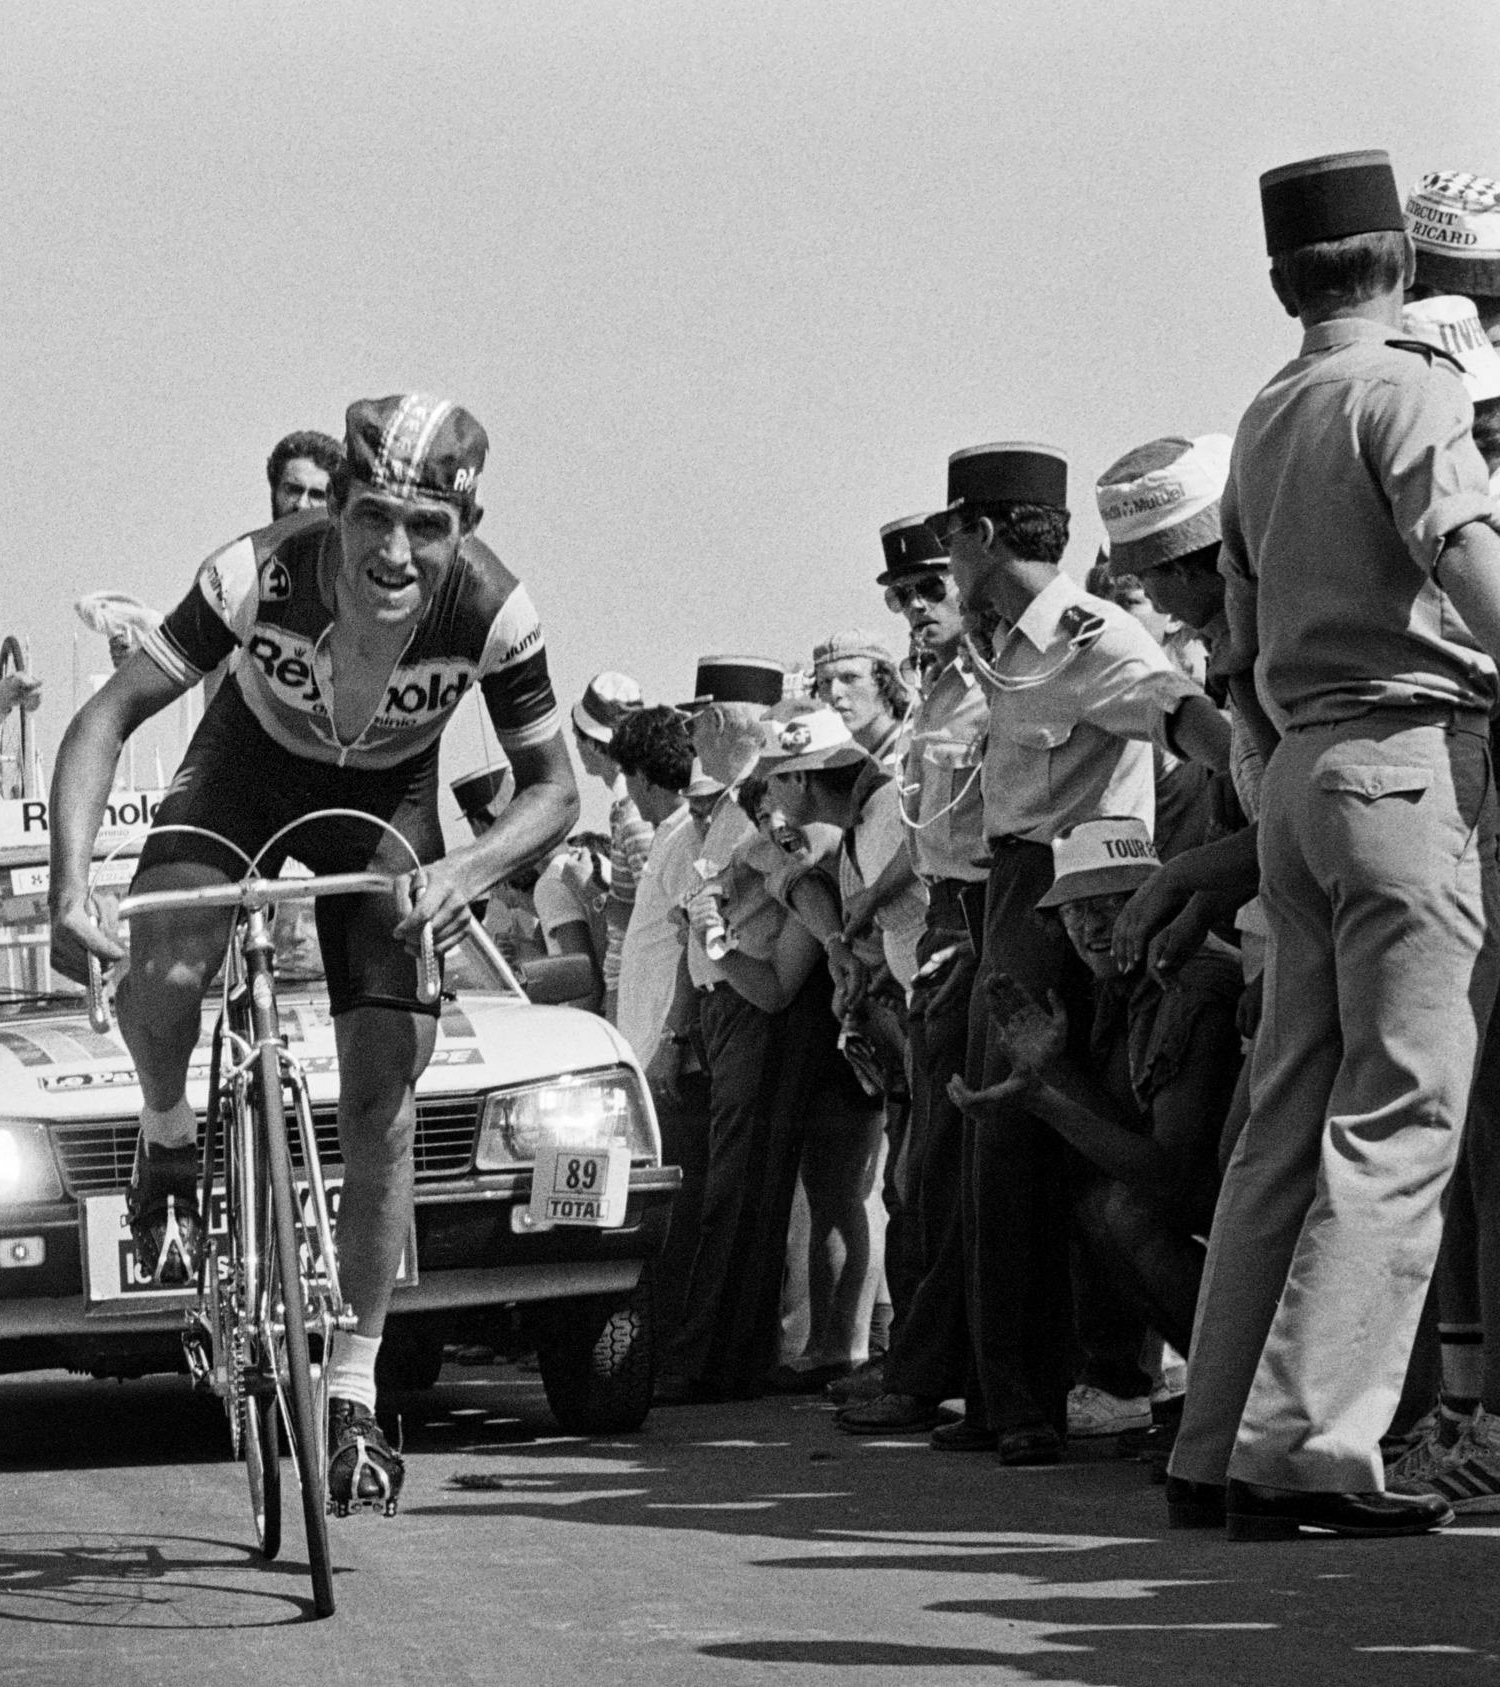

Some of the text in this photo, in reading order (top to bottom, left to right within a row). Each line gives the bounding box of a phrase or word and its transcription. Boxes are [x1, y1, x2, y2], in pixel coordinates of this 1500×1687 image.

[1412, 221, 1478, 246] RICARD
[1102, 838, 1148, 859] TOUR
[566, 1158, 598, 1189] 89
[550, 1199, 605, 1219] TOTAL
